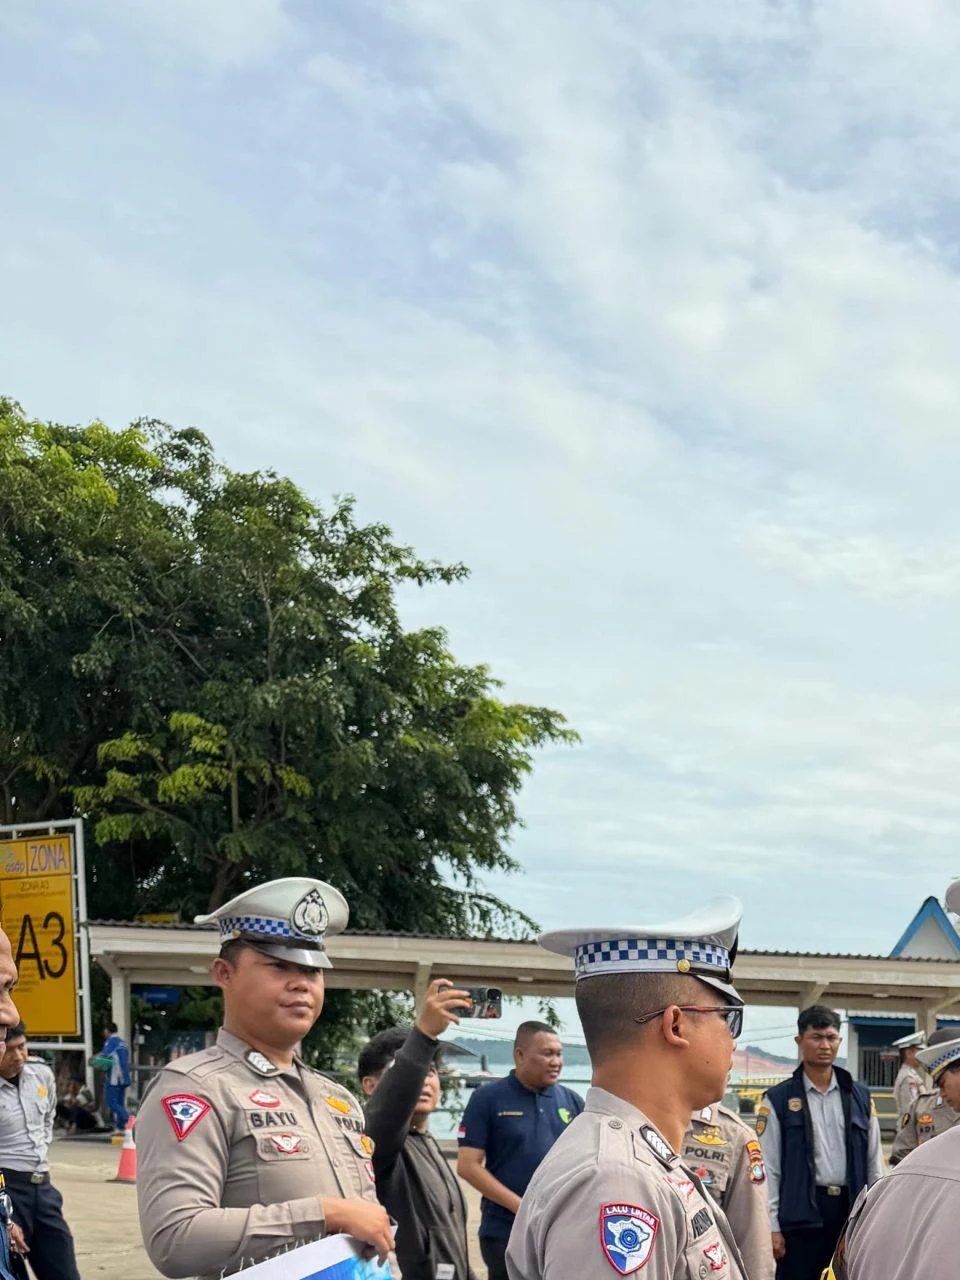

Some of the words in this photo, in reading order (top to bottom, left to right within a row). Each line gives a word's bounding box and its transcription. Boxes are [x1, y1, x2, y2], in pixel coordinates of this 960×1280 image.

[30, 843, 67, 872] ZONA
[15, 911, 68, 980] A3
[250, 1112, 297, 1127] BAYU
[685, 1146, 725, 1162] POLRI
[606, 1206, 628, 1214] LALU
[631, 1208, 656, 1226] LINTAS
